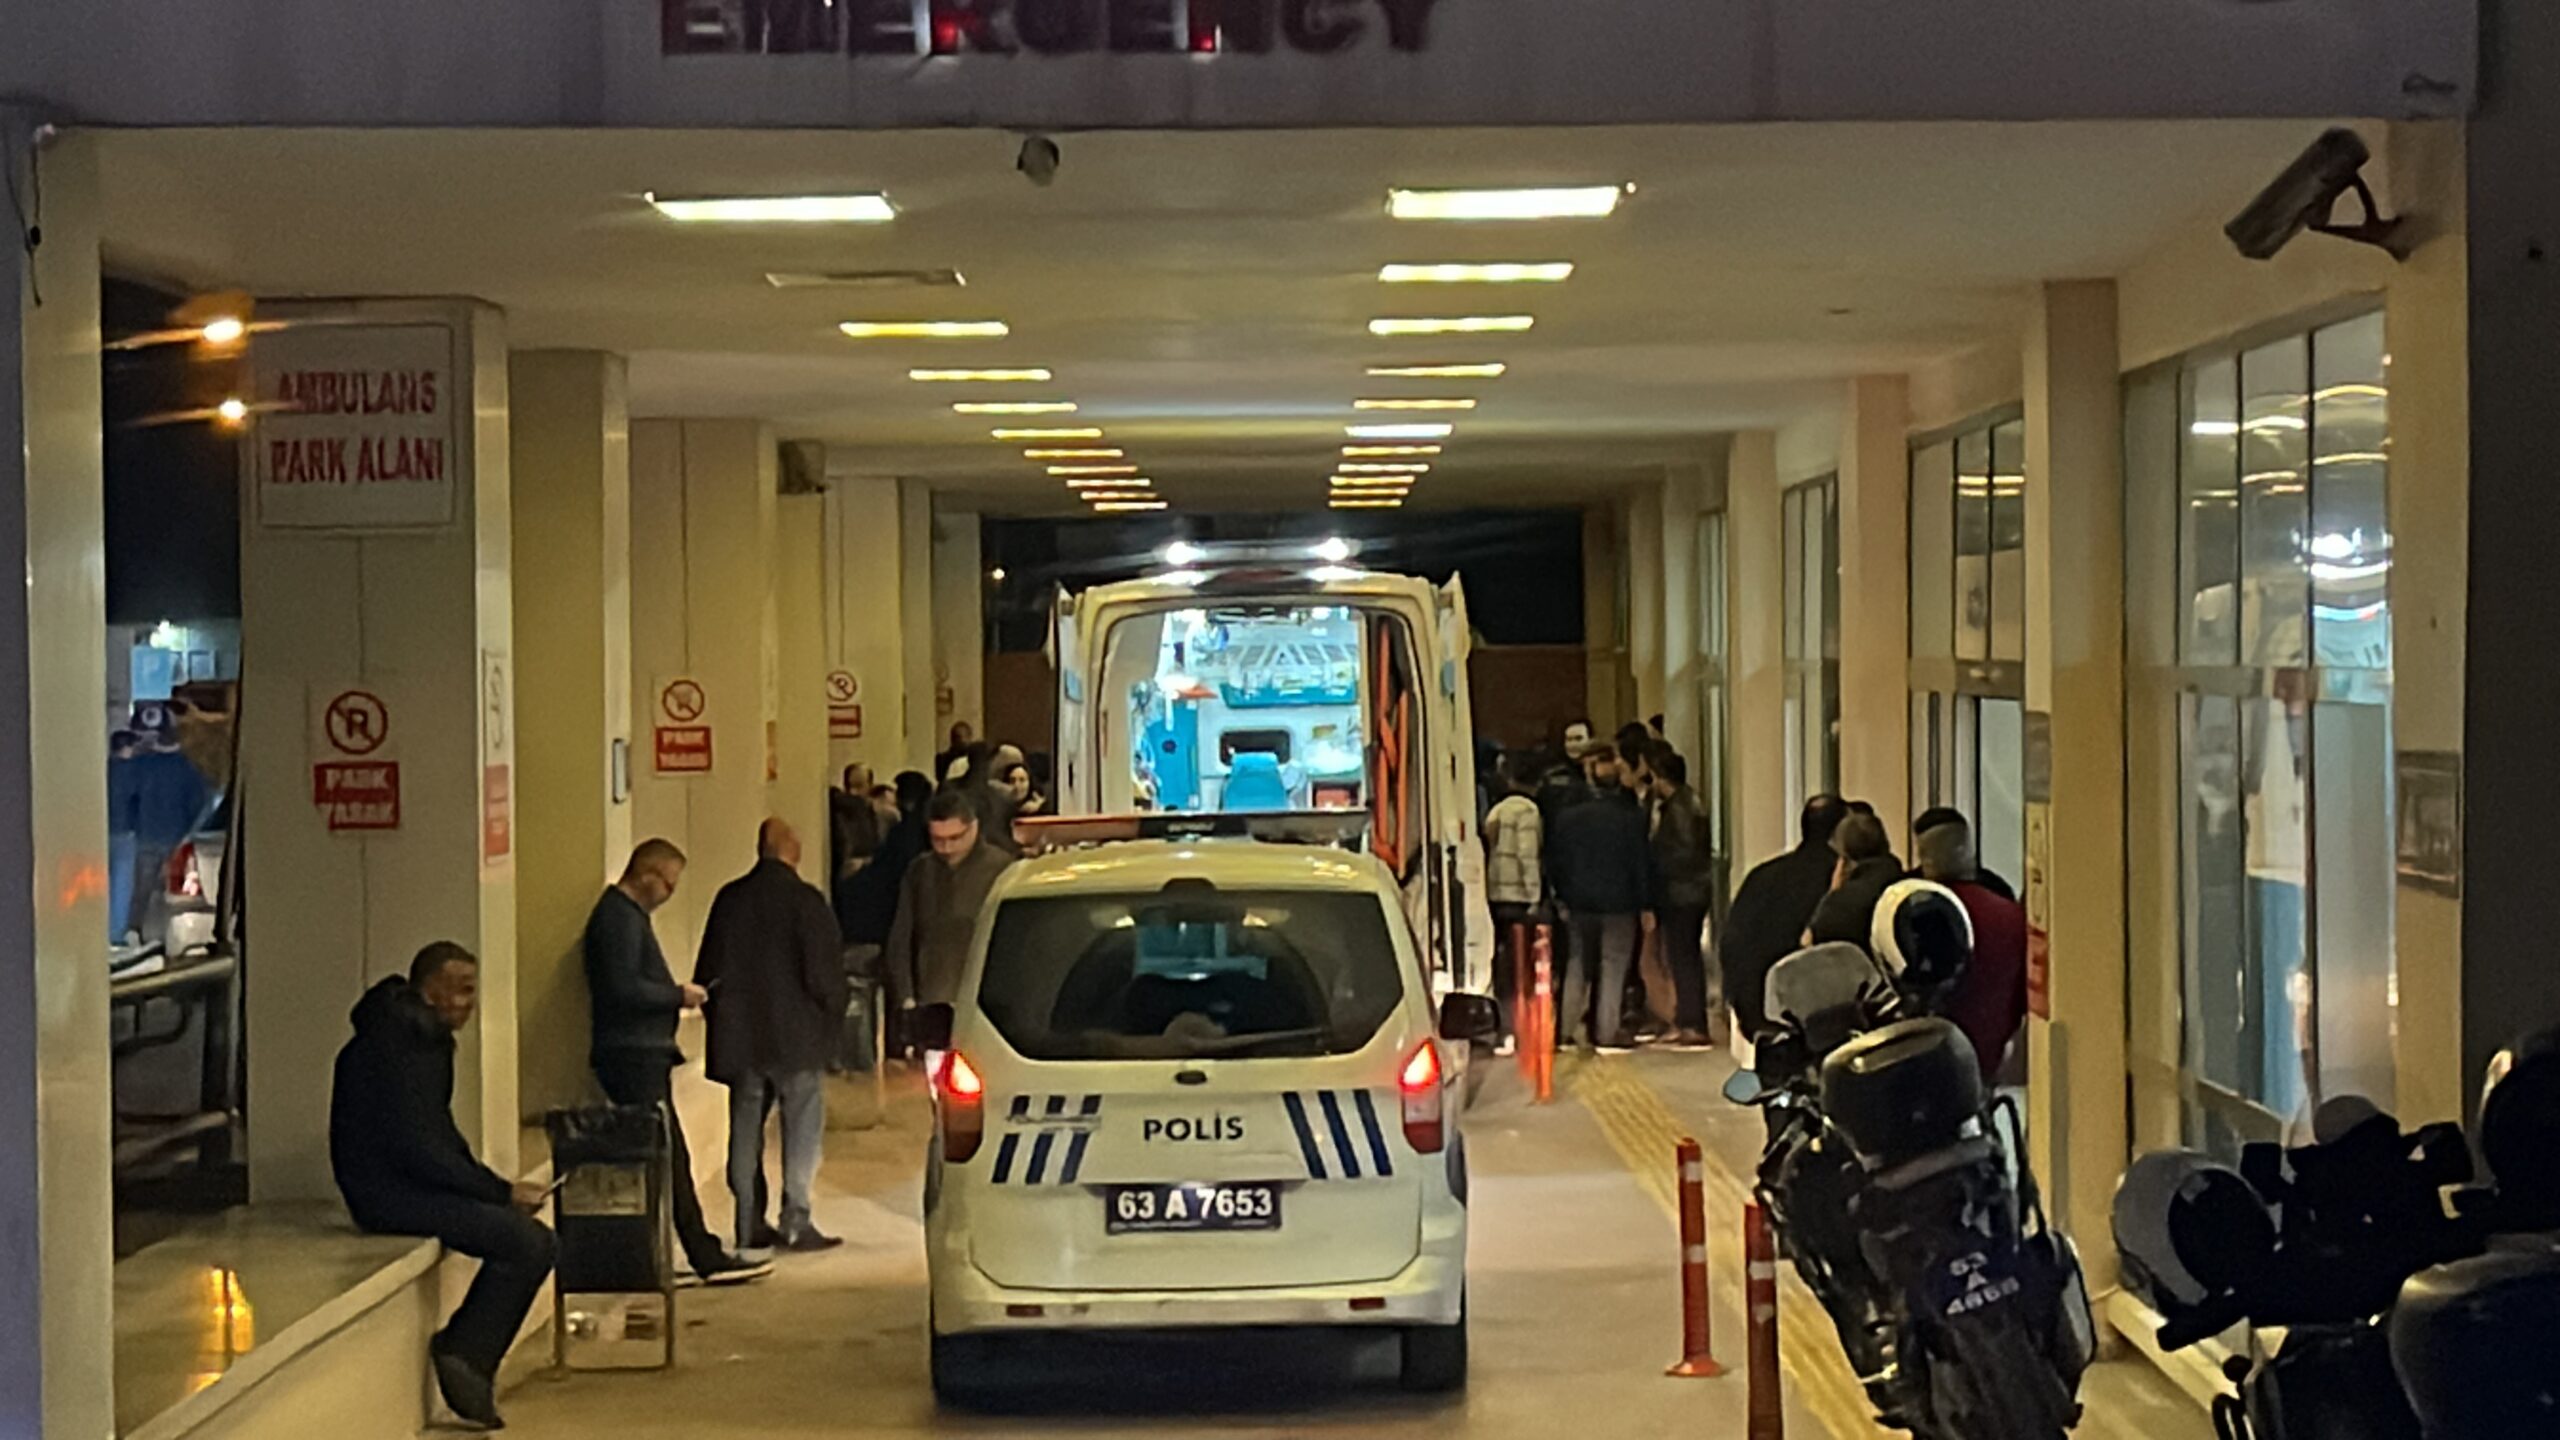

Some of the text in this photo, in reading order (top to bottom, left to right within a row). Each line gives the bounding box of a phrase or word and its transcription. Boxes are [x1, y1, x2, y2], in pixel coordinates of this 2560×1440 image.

[276, 371, 437, 415] AMBULANS
[271, 437, 443, 483] PARK ALANI
[326, 768, 390, 789] PARK
[1144, 1111, 1243, 1141] POLİS
[1117, 1187, 1273, 1219] 63 A 7653
